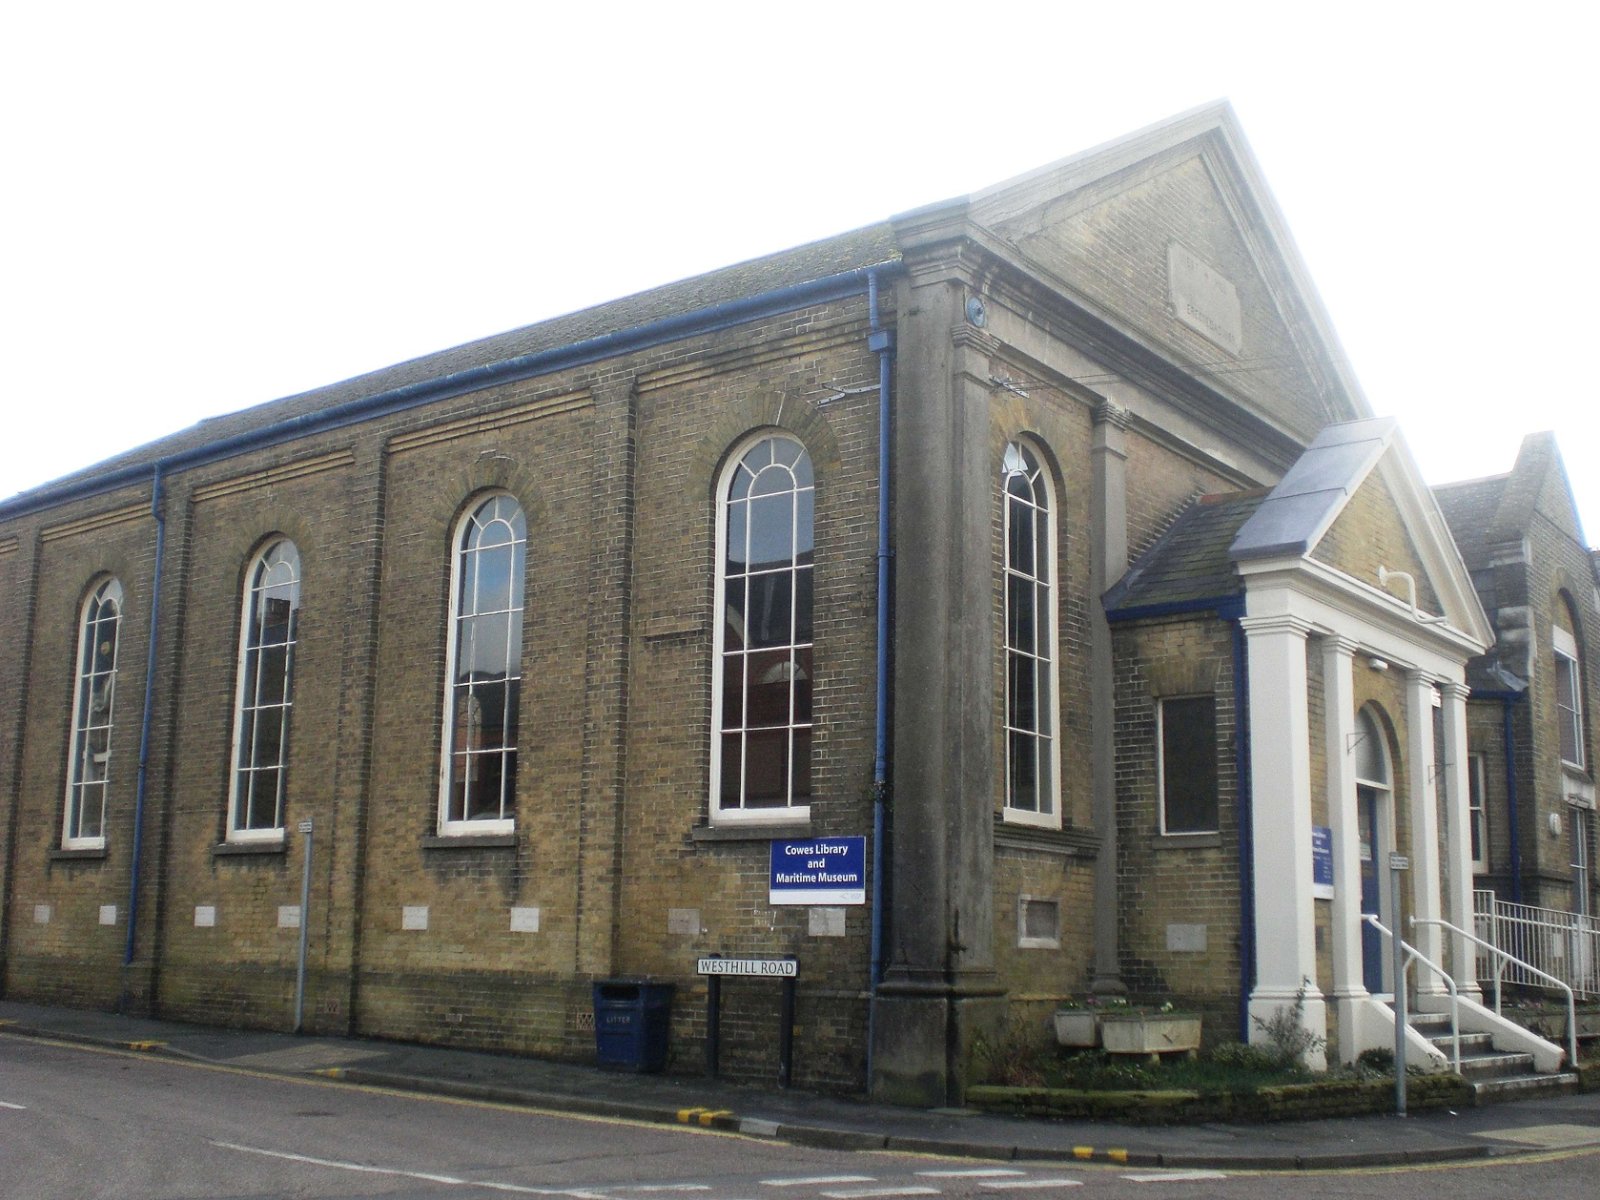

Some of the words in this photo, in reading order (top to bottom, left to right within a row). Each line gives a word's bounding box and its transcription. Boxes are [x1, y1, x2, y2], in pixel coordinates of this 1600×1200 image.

[785, 845, 813, 855] Cowes
[815, 844, 848, 856] Library
[807, 858, 825, 868] and
[776, 873, 816, 883] Maritime
[818, 872, 857, 882] Museum
[701, 960, 757, 974] WESTHILL
[761, 962, 794, 975] ROAD
[606, 1016, 631, 1024] LITTER
